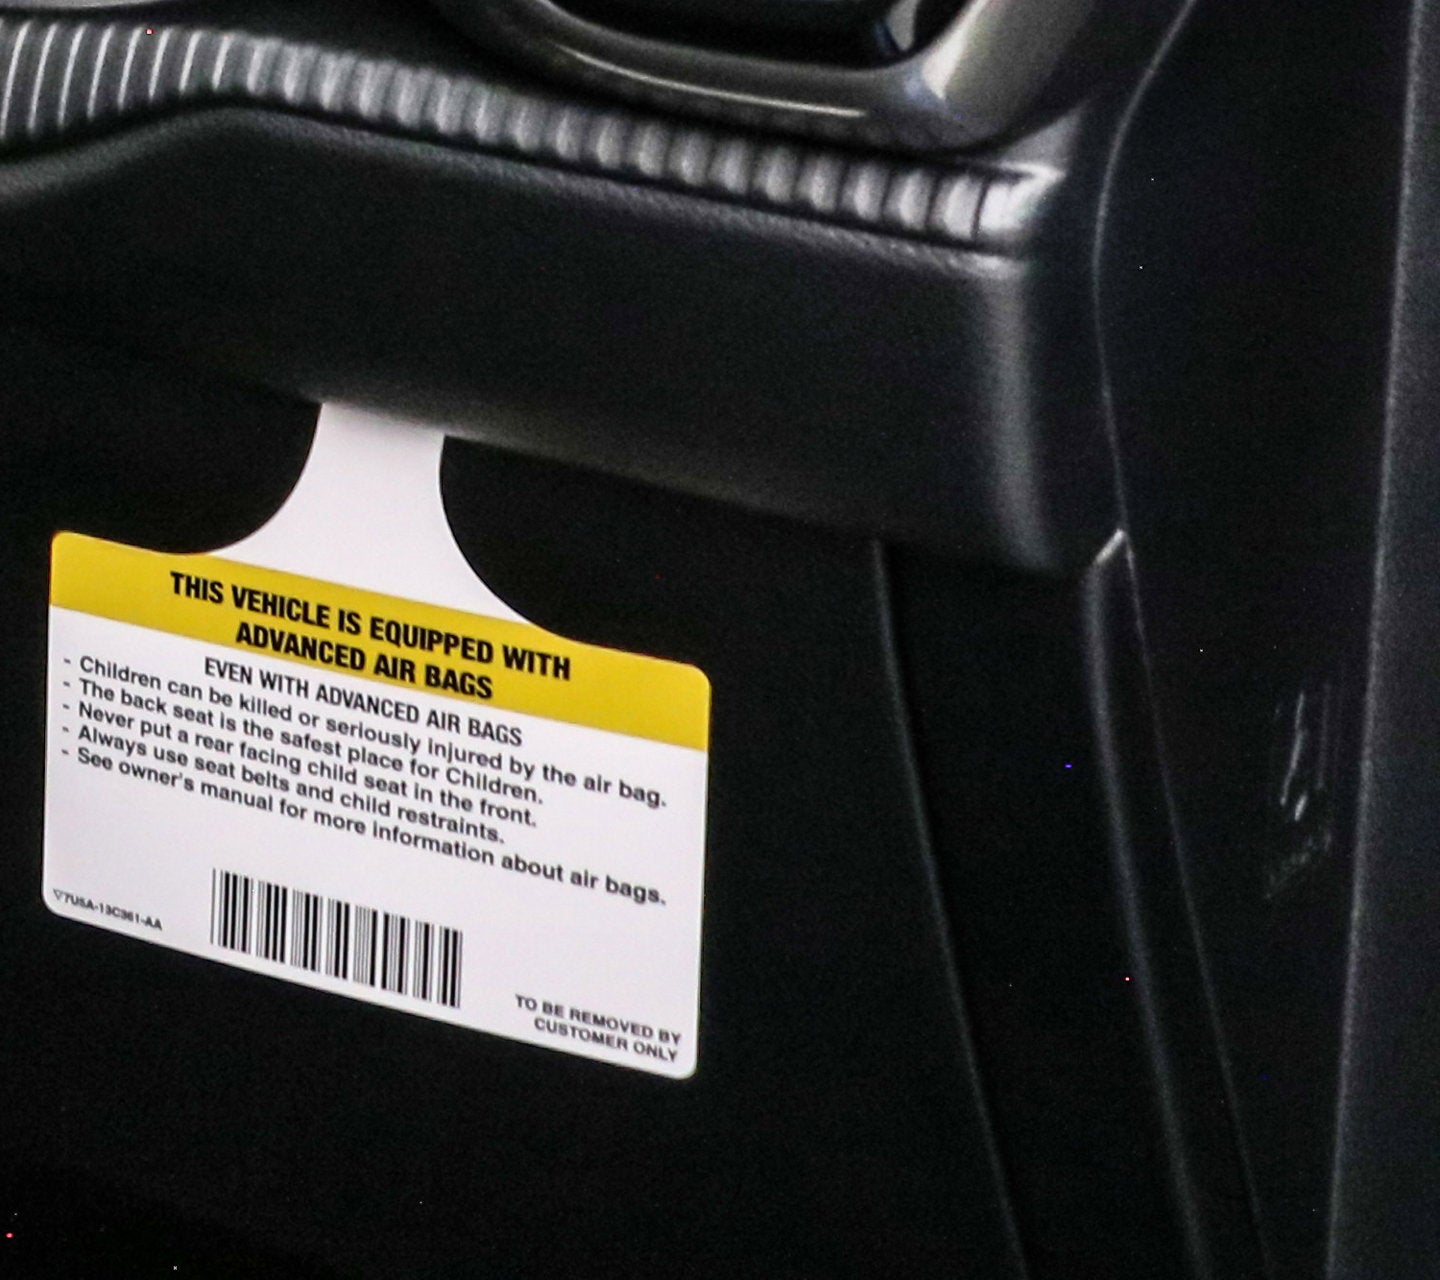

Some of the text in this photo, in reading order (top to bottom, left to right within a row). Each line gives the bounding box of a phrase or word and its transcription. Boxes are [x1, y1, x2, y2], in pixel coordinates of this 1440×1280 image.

[169, 570, 571, 682] THIS VEHICLE IS EQUIPPED WITH
[235, 621, 493, 701] ADVANCED AIR BAGS
[78, 677, 115, 702] The
[120, 687, 167, 716] back
[172, 705, 214, 728] seat
[219, 711, 237, 732] is
[242, 718, 274, 741] the
[280, 731, 342, 758] safest
[347, 746, 404, 772] place
[409, 757, 440, 780] for
[445, 766, 543, 805] Children.
[79, 655, 162, 691] Children
[167, 680, 203, 701] can
[208, 686, 233, 708] be
[239, 693, 293, 722] killed
[297, 712, 320, 728] or
[326, 718, 421, 756] seriously
[428, 737, 503, 771] injured
[509, 755, 536, 782] by
[542, 764, 577, 787] the
[583, 774, 612, 794] air
[618, 779, 667, 810] bag.
[204, 656, 523, 747] EVEN WITH ADVANCED AIR BAGS
[78, 700, 135, 730] Never
[140, 719, 172, 740] put
[177, 729, 189, 744] a
[194, 733, 235, 755] rear
[239, 741, 302, 776] facing
[307, 760, 358, 786] child
[364, 775, 408, 798] seat
[413, 782, 433, 803] in
[439, 789, 474, 813] the
[479, 798, 536, 827] front.
[78, 724, 147, 758] Always
[153, 746, 189, 767] use
[194, 756, 236, 780] seat
[241, 764, 290, 793] belts
[296, 782, 334, 804] and
[339, 791, 391, 818] child
[397, 806, 505, 844] restraints.
[77, 746, 113, 771] See
[118, 761, 195, 792] owner's
[200, 781, 274, 812] manual
[279, 797, 308, 820] for
[313, 810, 367, 835] more
[372, 820, 495, 866] information
[501, 853, 564, 883] about
[569, 869, 599, 889] air
[605, 874, 666, 905] bags.
[515, 994, 681, 1046] TO BE REMOVED BY
[534, 1017, 677, 1063] CUSTOMER ONLY
